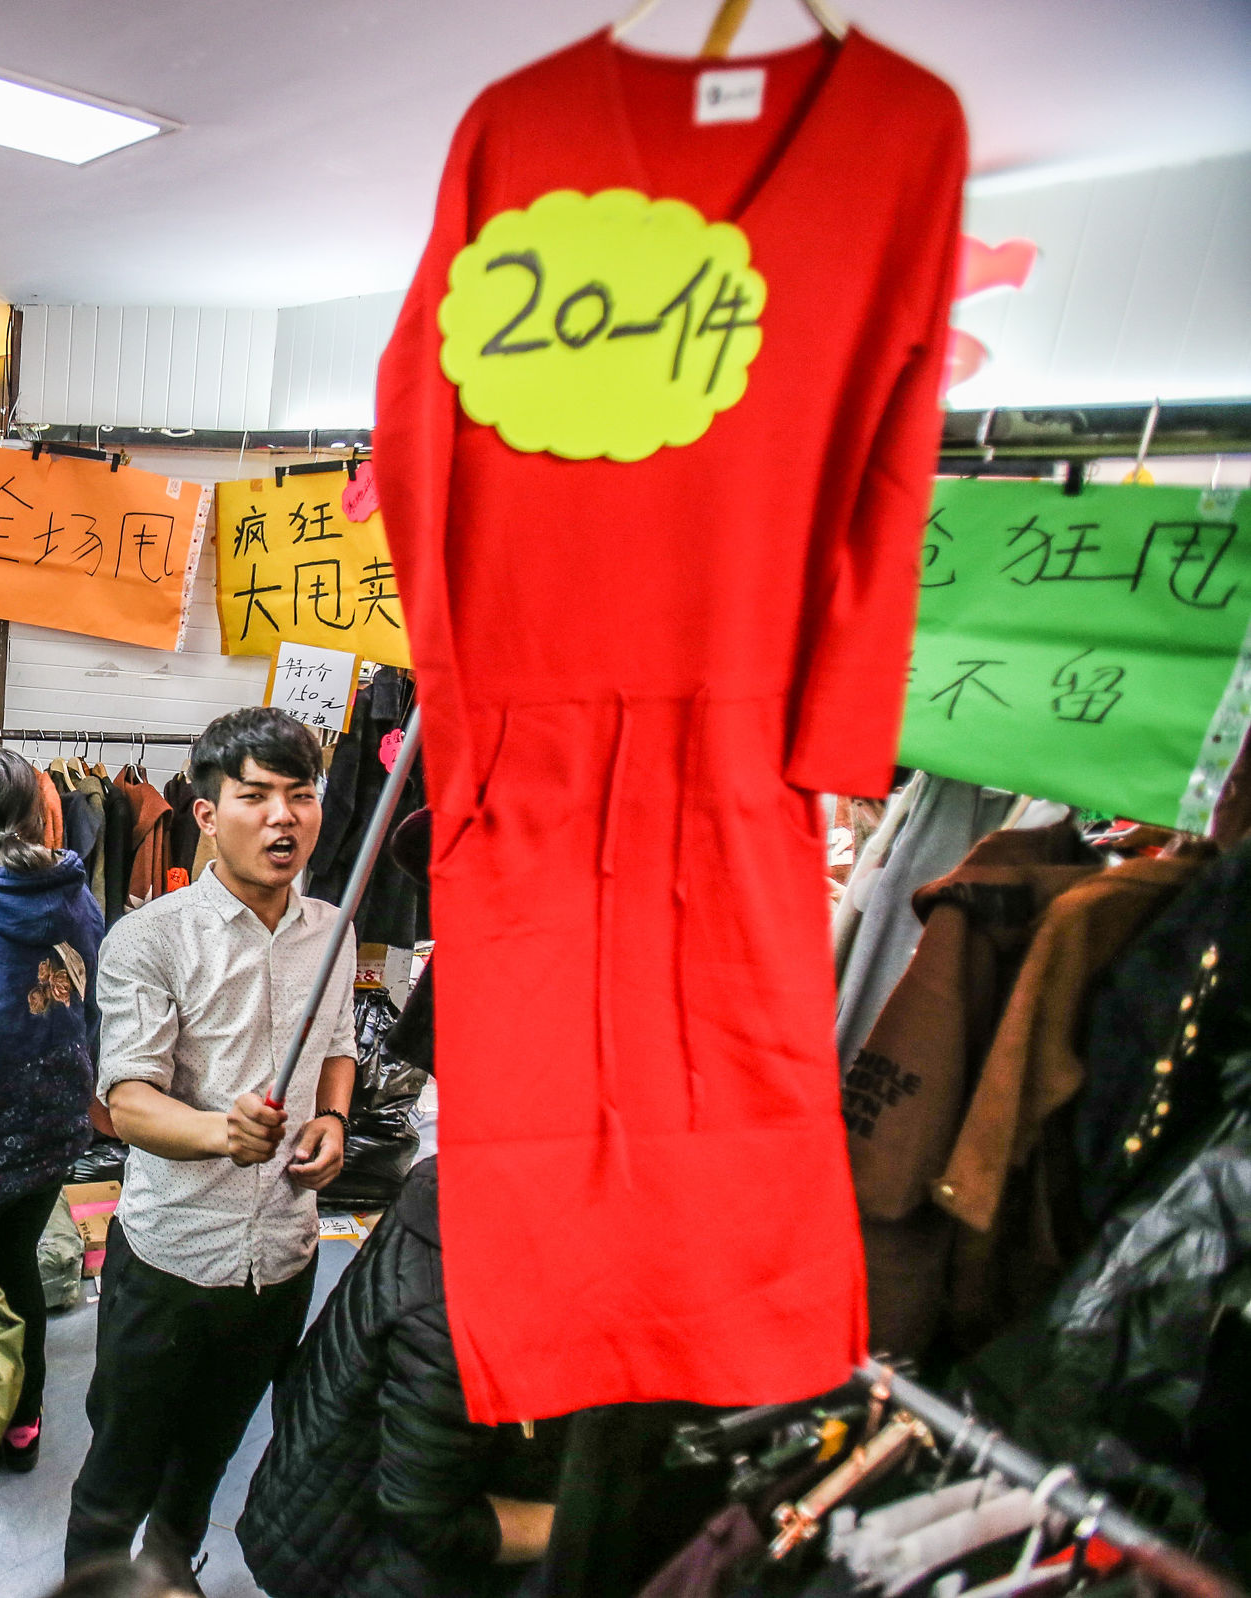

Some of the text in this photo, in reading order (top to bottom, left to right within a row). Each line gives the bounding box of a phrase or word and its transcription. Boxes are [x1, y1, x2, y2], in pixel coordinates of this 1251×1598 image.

[234, 502, 343, 559] 疯狂
[234, 556, 401, 640] 大甩卖
[276, 657, 332, 682] 特价
[286, 684, 345, 709] 150元
[908, 648, 1126, 724] 不留
